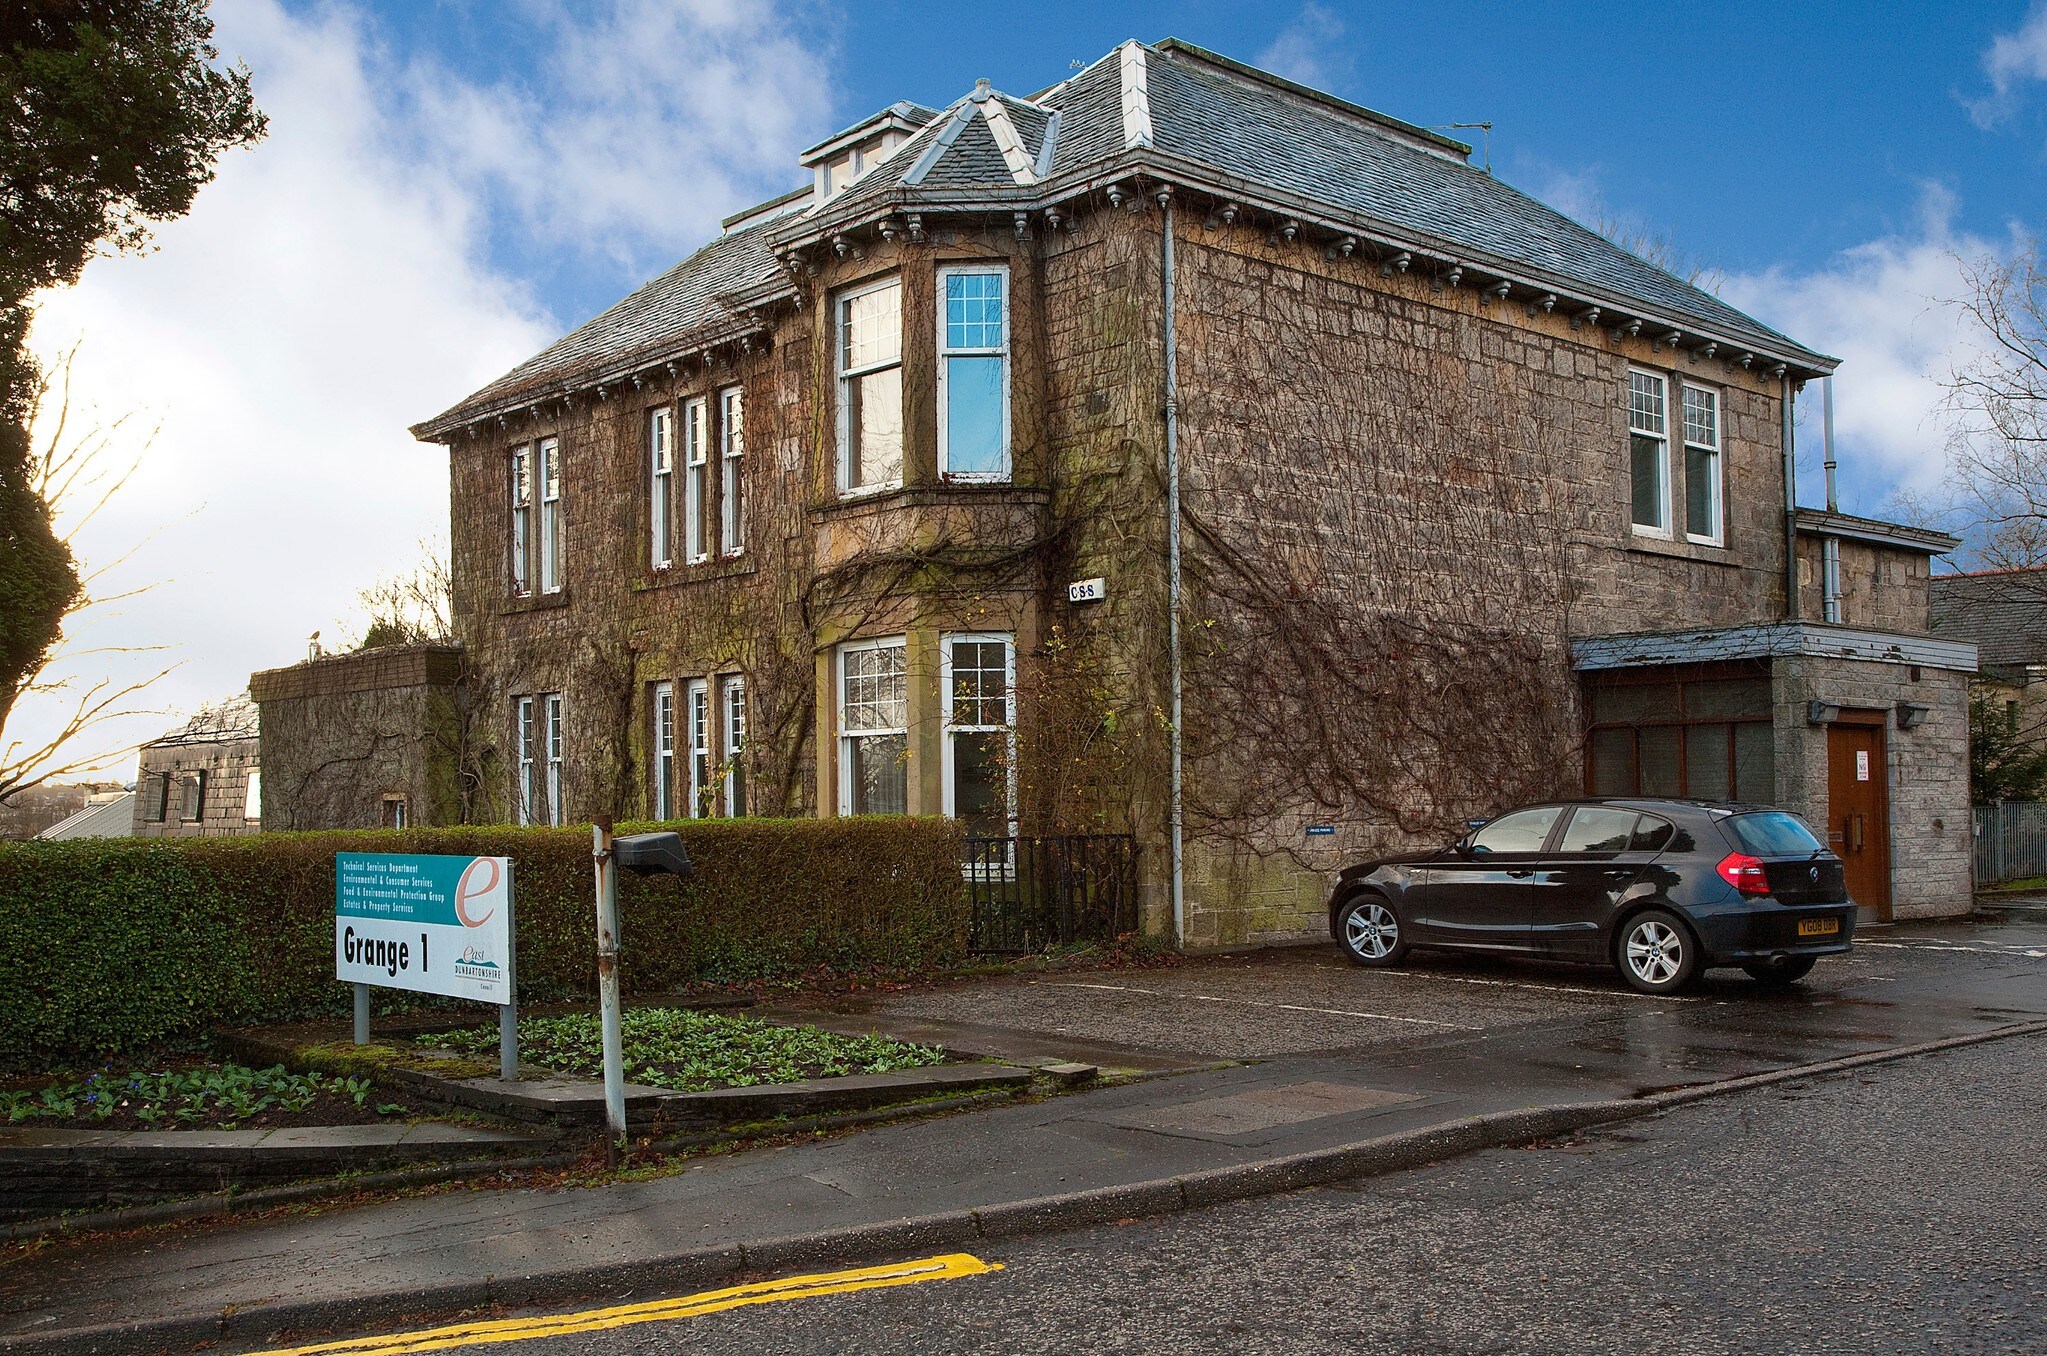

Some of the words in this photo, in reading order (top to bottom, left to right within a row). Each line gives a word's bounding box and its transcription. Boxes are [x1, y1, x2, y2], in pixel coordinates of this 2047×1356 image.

[343, 861, 364, 871] Technical
[367, 862, 386, 872] Services
[389, 863, 418, 874] Department
[343, 873, 377, 884] Environmental
[380, 875, 383, 885] &
[386, 875, 409, 886] Consumer
[412, 877, 432, 887] Services
[343, 886, 354, 896] Food
[357, 887, 360, 896] &
[363, 887, 398, 899] Environmental
[400, 889, 426, 901] Protection
[429, 891, 445, 904] Group
[343, 899, 360, 909] Estates
[363, 900, 366, 909] &
[369, 901, 390, 913] Property
[392, 902, 413, 913] Services
[344, 925, 409, 977] Grange
[421, 933, 428, 972] 1
[463, 946, 485, 963] east
[455, 965, 501, 980] DUNBARTONSHIRE
